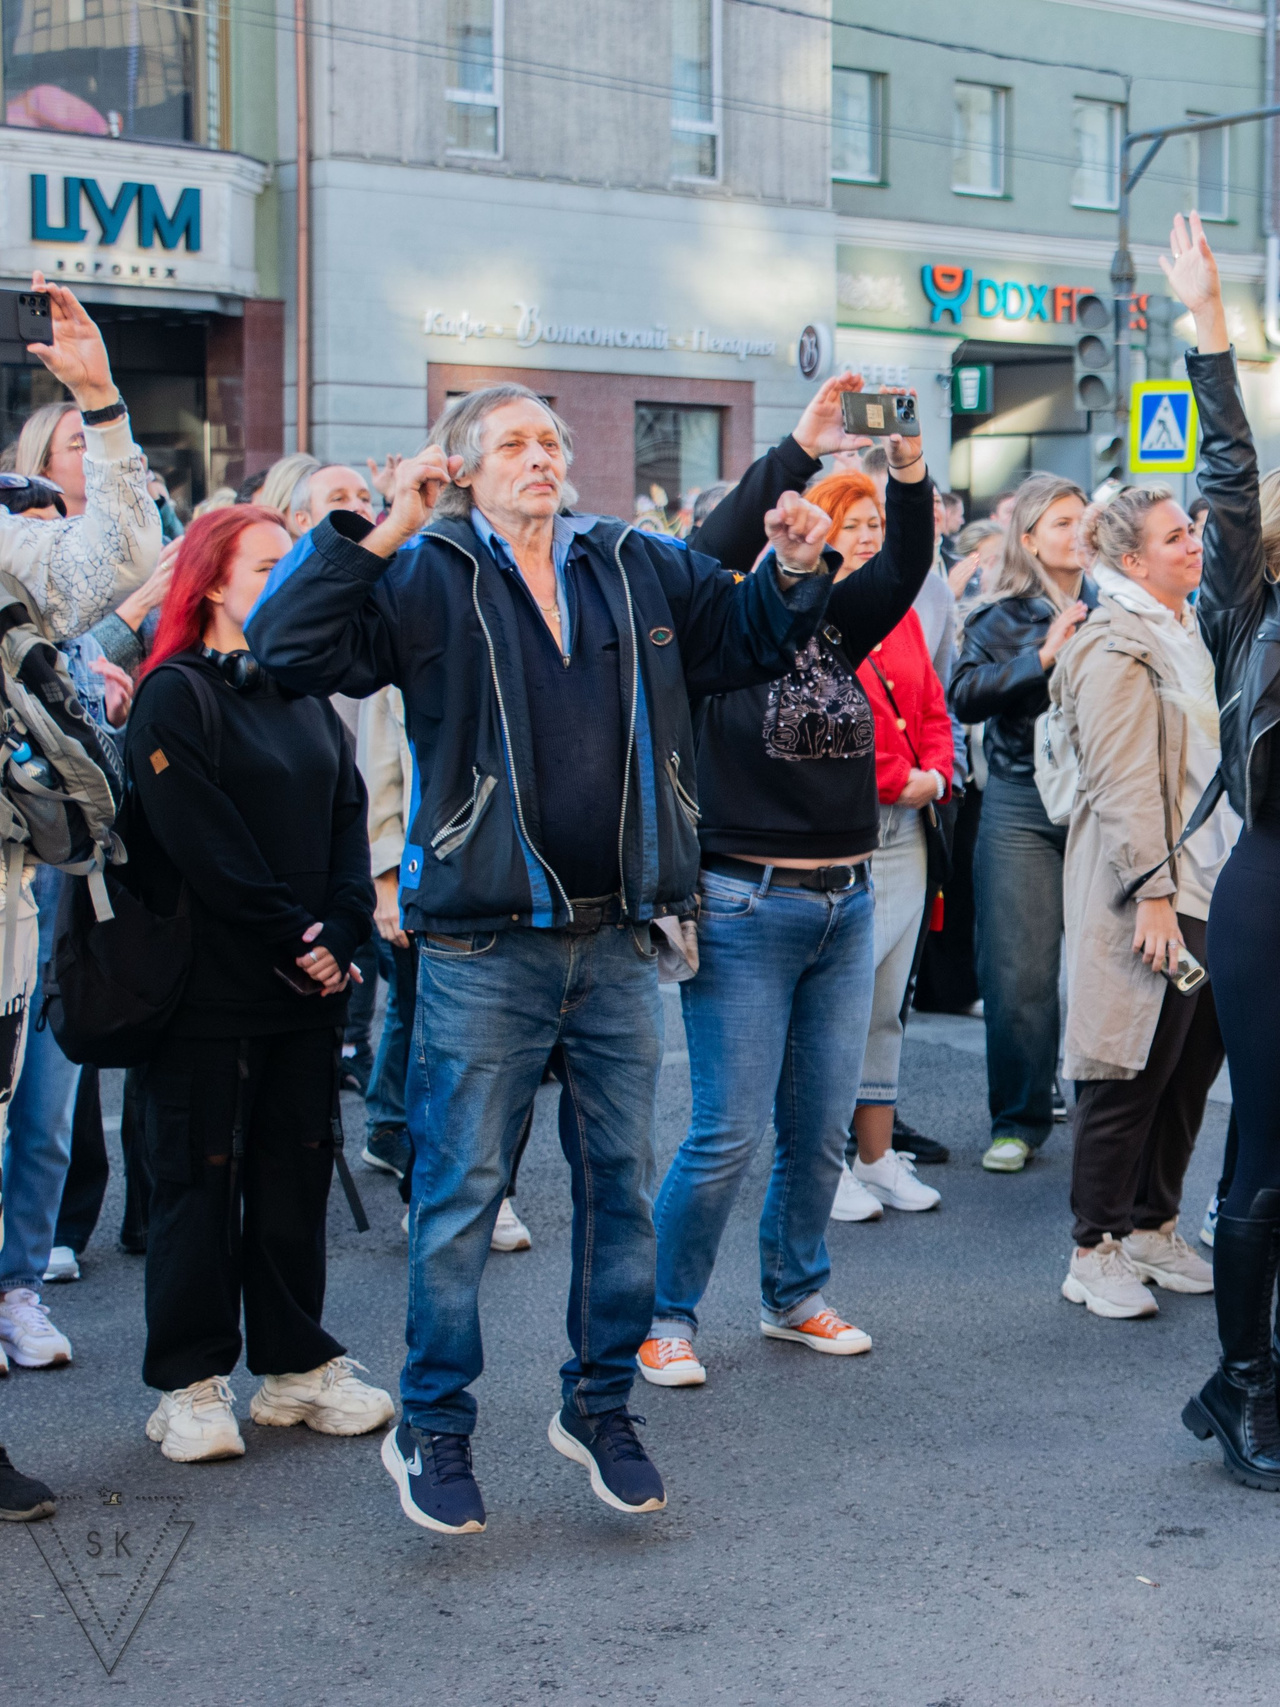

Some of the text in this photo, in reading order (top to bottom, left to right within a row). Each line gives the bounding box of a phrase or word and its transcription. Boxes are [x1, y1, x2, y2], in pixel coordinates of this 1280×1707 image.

[31, 173, 202, 253] ЦУМ
[56, 260, 178, 280] ВОРОНЕЖ
[977, 278, 1049, 322] DDX
[423, 301, 776, 361] Кафе Волконский Пекарня
